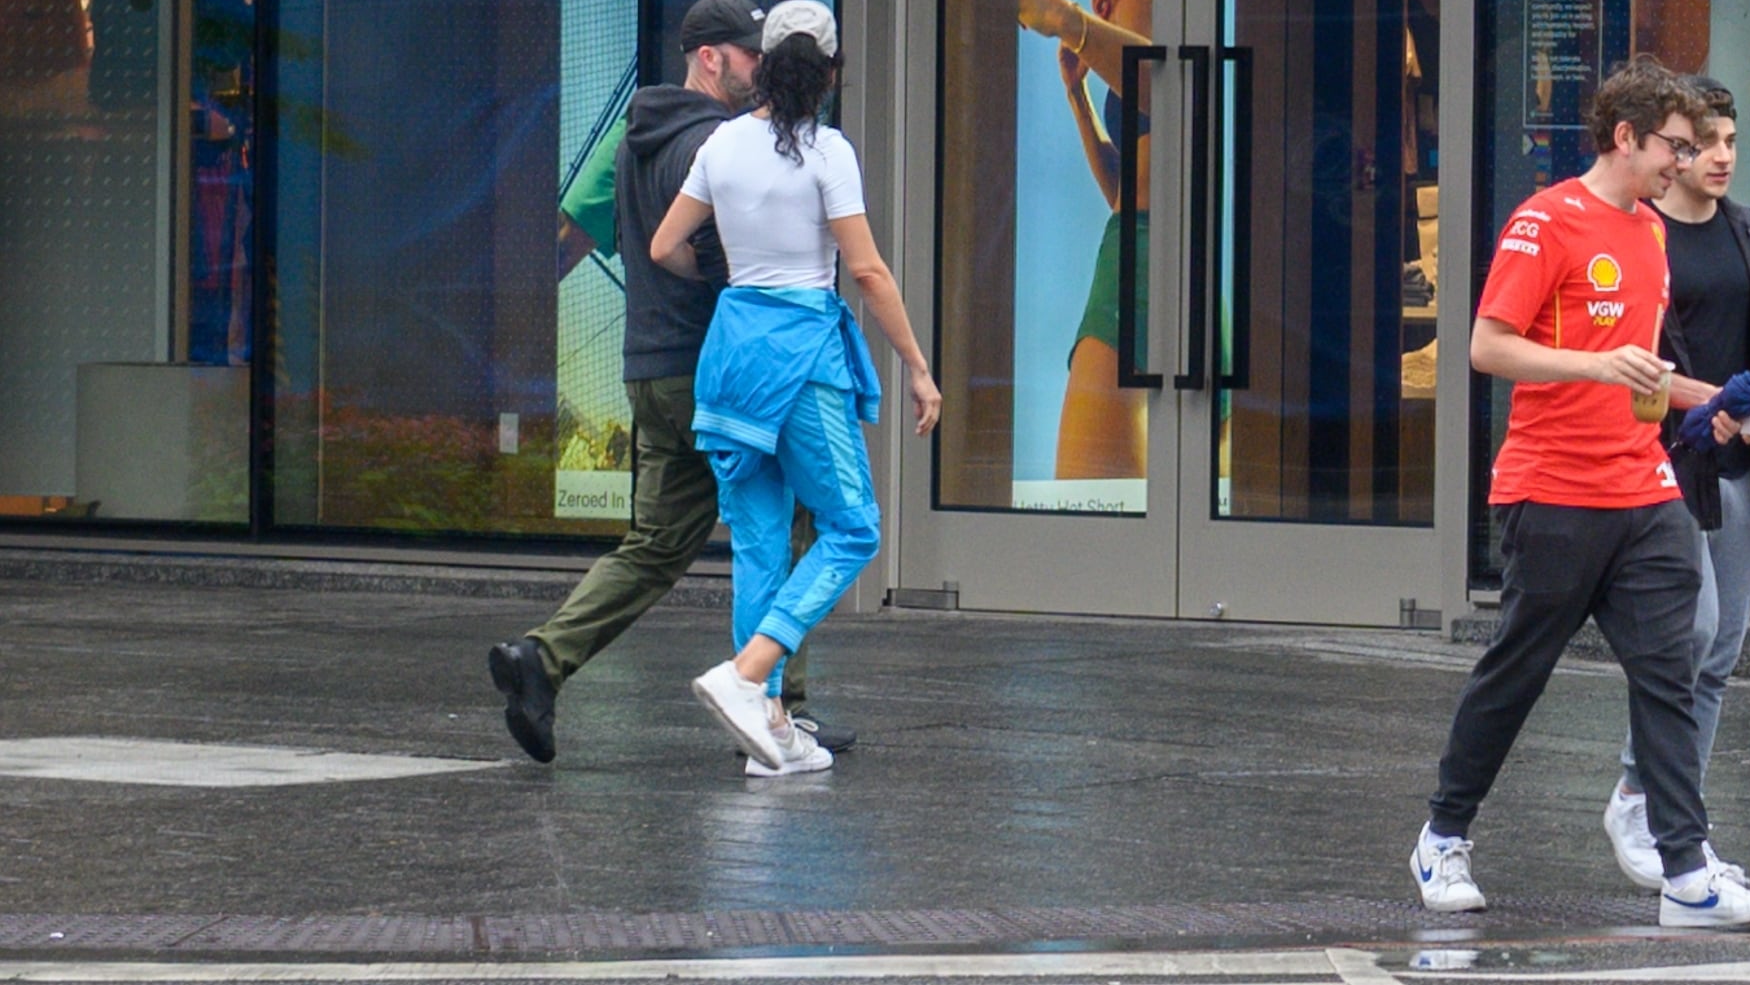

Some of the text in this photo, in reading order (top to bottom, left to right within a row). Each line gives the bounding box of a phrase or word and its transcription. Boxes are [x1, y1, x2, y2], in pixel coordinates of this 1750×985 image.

[1587, 301, 1625, 318] VGW
[558, 489, 625, 509] Zeroed In
